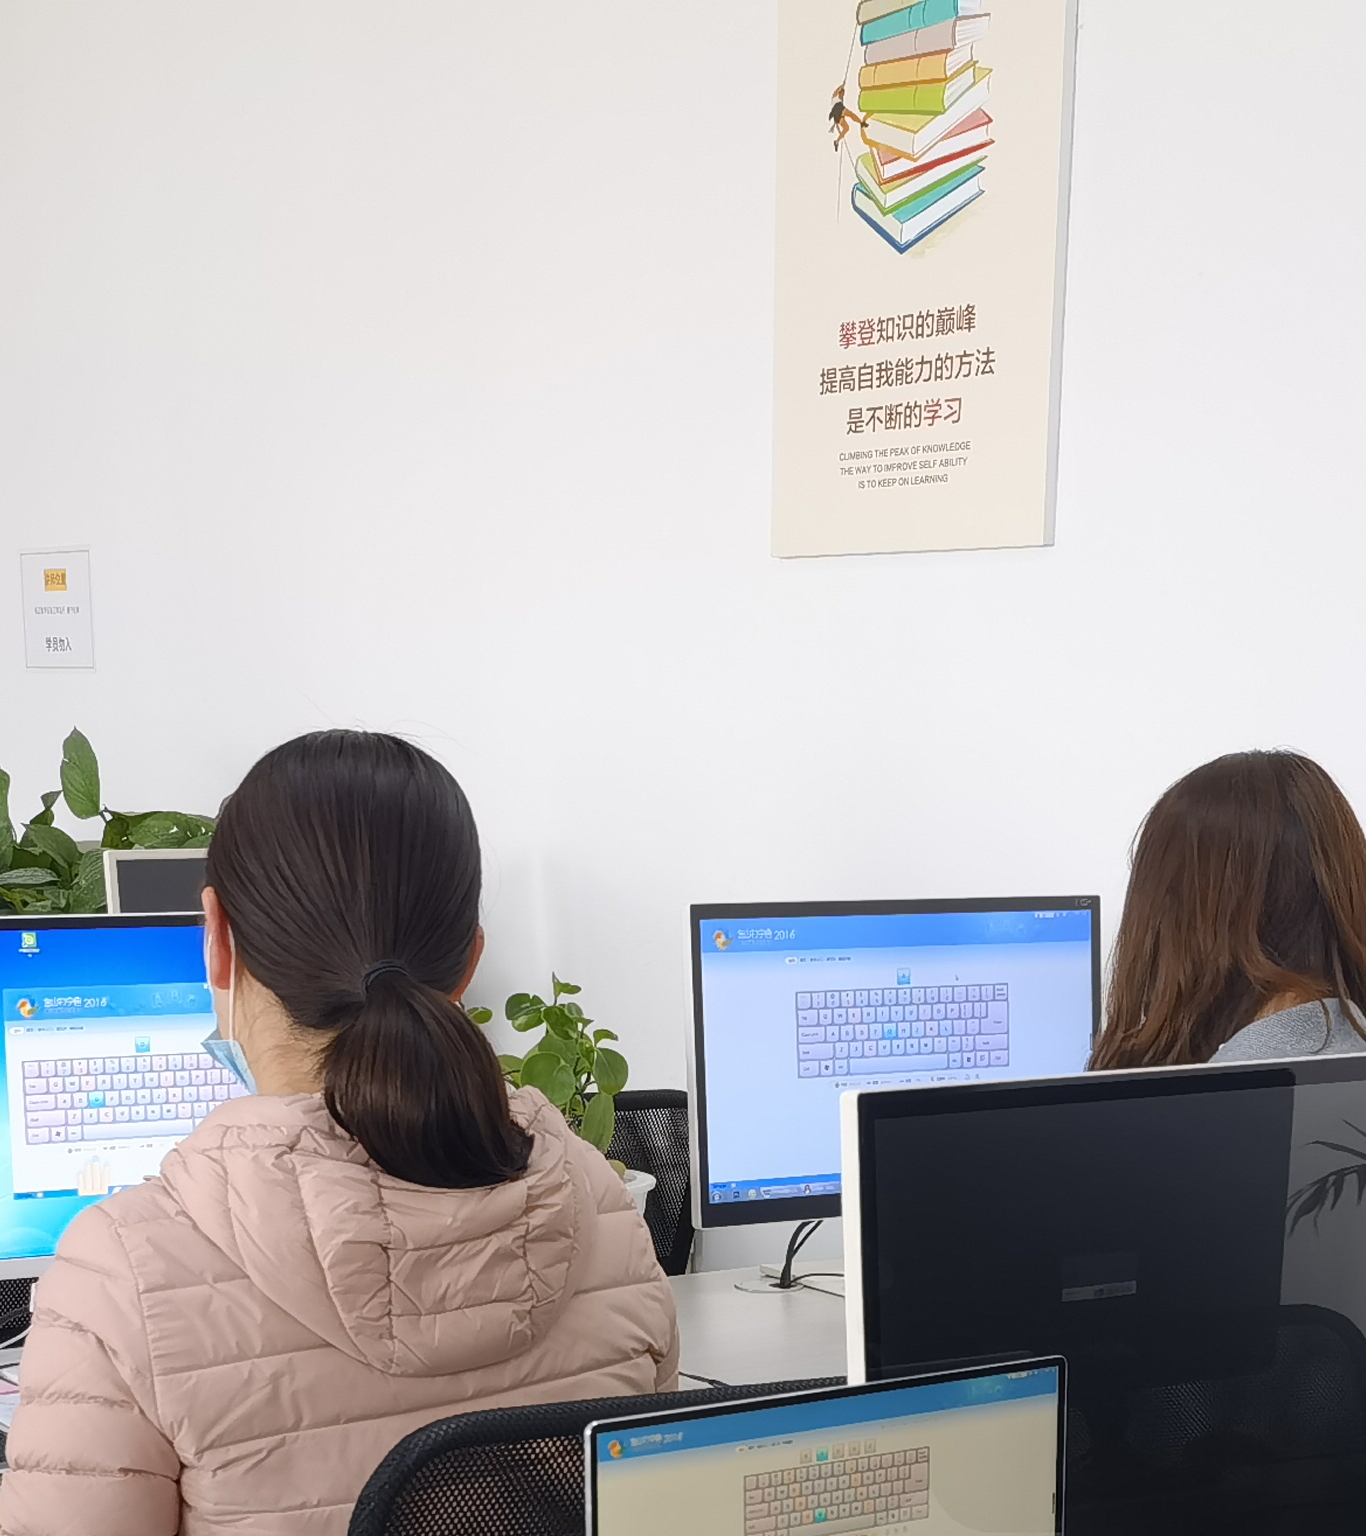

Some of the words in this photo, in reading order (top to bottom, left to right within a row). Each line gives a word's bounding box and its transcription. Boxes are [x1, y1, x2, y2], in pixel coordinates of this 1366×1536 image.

[838, 303, 976, 350] 攀登知识的巅峰
[819, 346, 996, 396] 提高自我能力的方法
[846, 397, 963, 435] 是不断的学习
[839, 450, 874, 462] CLIMBING
[875, 448, 889, 459] THE
[889, 447, 910, 458] PEAK
[910, 446, 921, 455] OF
[922, 441, 972, 454] KNOWLEDGE
[840, 467, 855, 476] THE
[855, 464, 872, 475] WAY
[873, 464, 884, 474] TO
[884, 461, 918, 473] IMPROVE
[919, 459, 938, 469] SELF
[938, 457, 968, 468] ABILITY
[858, 480, 866, 489] IS
[866, 480, 877, 489] TO
[878, 478, 898, 488] KEEP
[898, 477, 910, 487] ON
[910, 474, 948, 486] LEARNING
